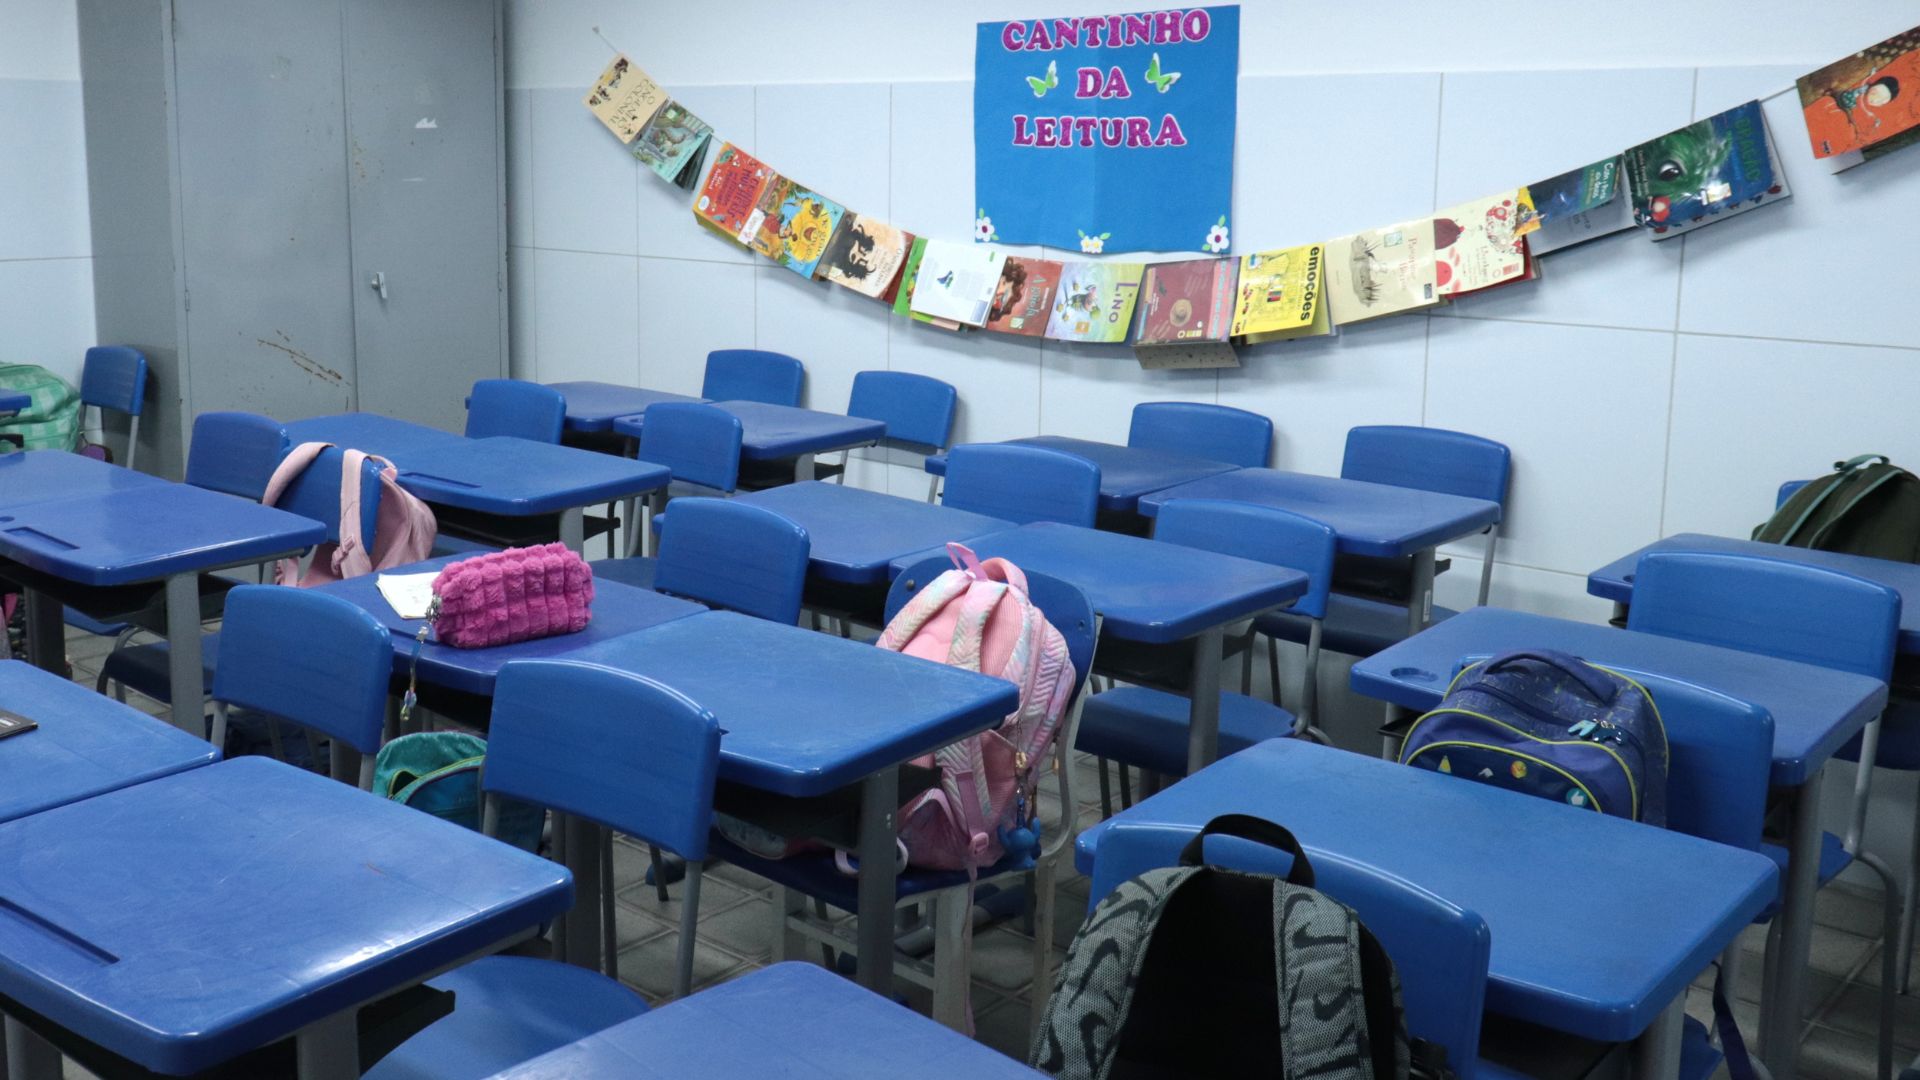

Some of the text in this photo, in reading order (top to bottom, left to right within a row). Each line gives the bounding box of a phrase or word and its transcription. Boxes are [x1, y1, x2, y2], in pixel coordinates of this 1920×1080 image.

[1002, 9, 1211, 52] CANTINHO
[1075, 66, 1131, 99] DA
[1012, 113, 1187, 148] LEITURA
[1109, 282, 1138, 324] LINO
[1300, 246, 1320, 321] emoções
